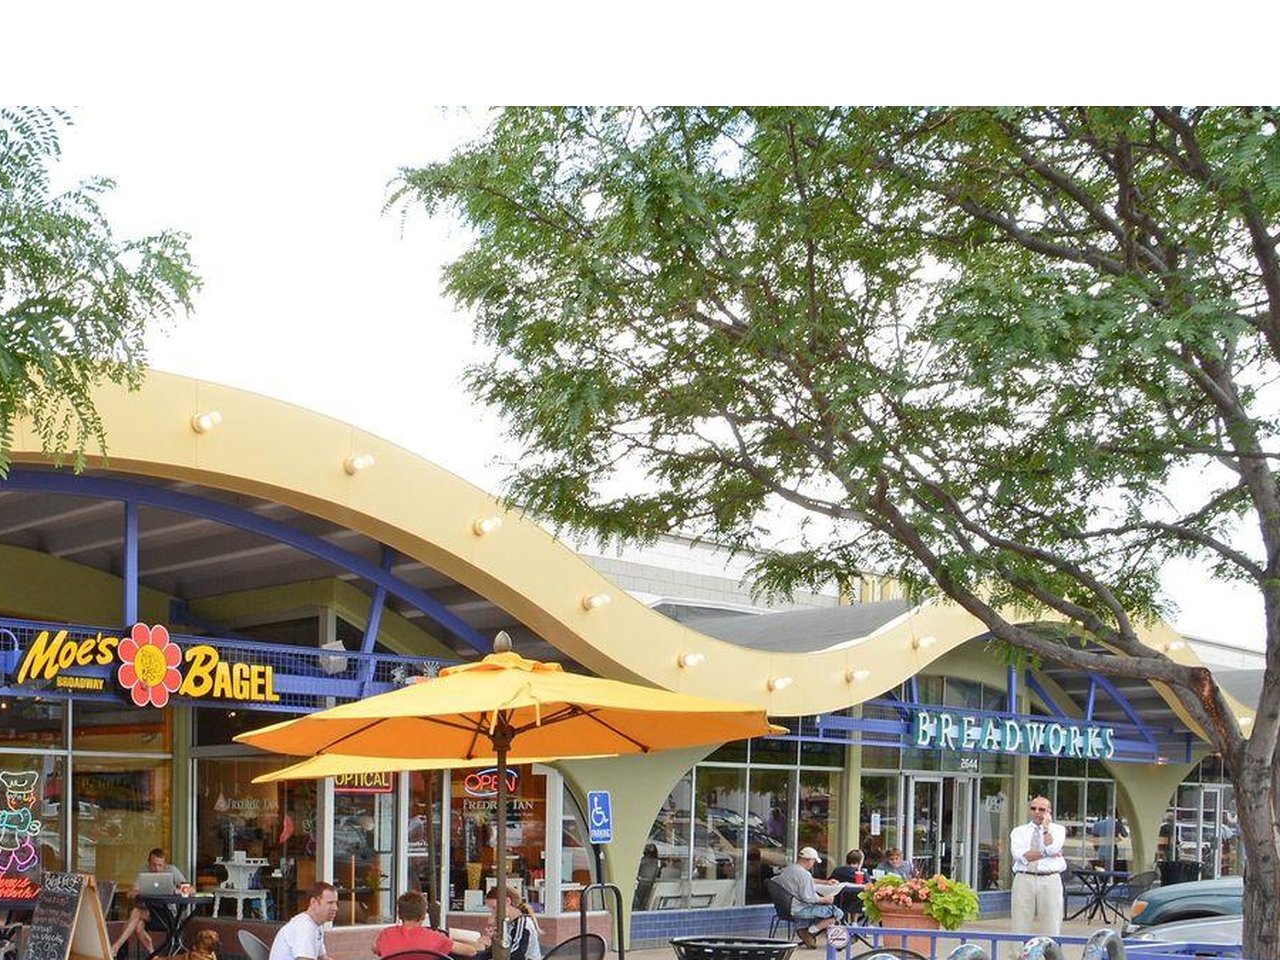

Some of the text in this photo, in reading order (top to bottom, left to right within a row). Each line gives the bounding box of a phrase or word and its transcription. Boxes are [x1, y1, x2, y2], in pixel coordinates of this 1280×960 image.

[19, 629, 280, 702] Moe's BAGEL
[56, 675, 105, 690] BROADWAY
[916, 710, 1116, 760] BREADWORKS
[335, 770, 389, 787] OPTICAL
[463, 799, 510, 810] FREDR
